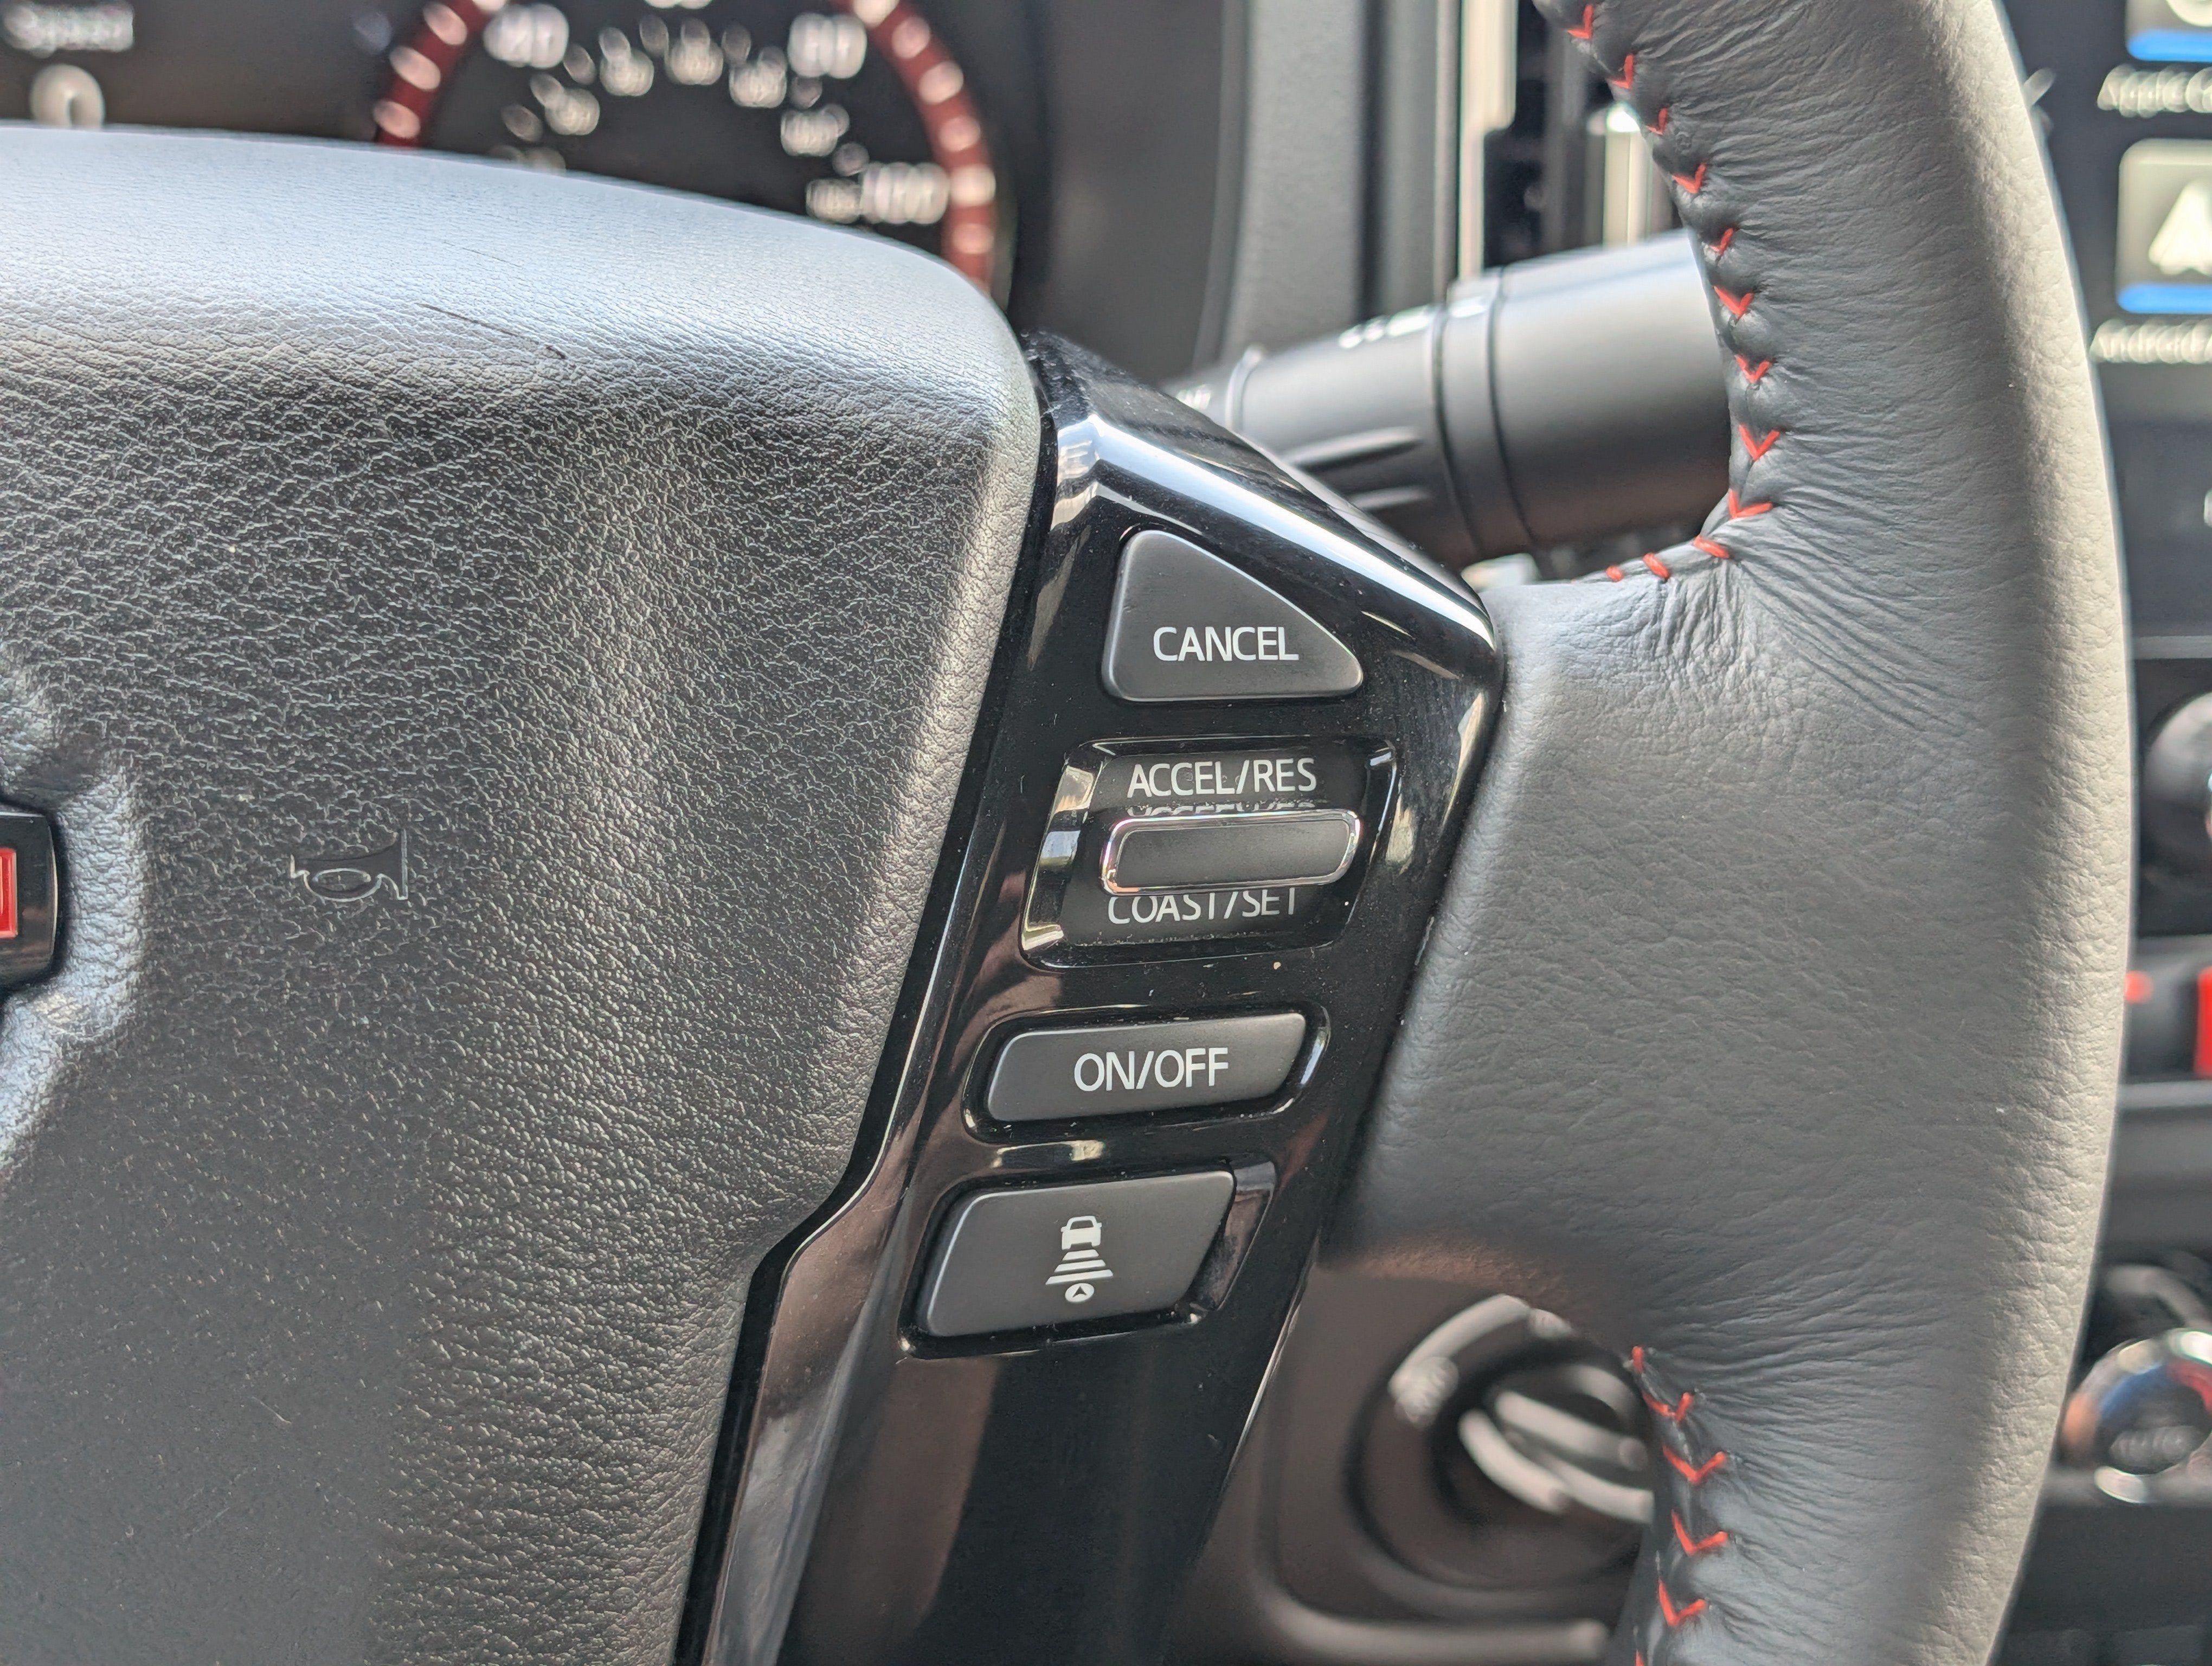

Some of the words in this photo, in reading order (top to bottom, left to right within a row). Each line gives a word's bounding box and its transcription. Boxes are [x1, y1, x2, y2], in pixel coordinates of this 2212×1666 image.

[1153, 626, 1300, 662] CANCEL
[1127, 758, 1317, 798] ACCEL/RES
[1073, 1047, 1229, 1092] ON/OFF
